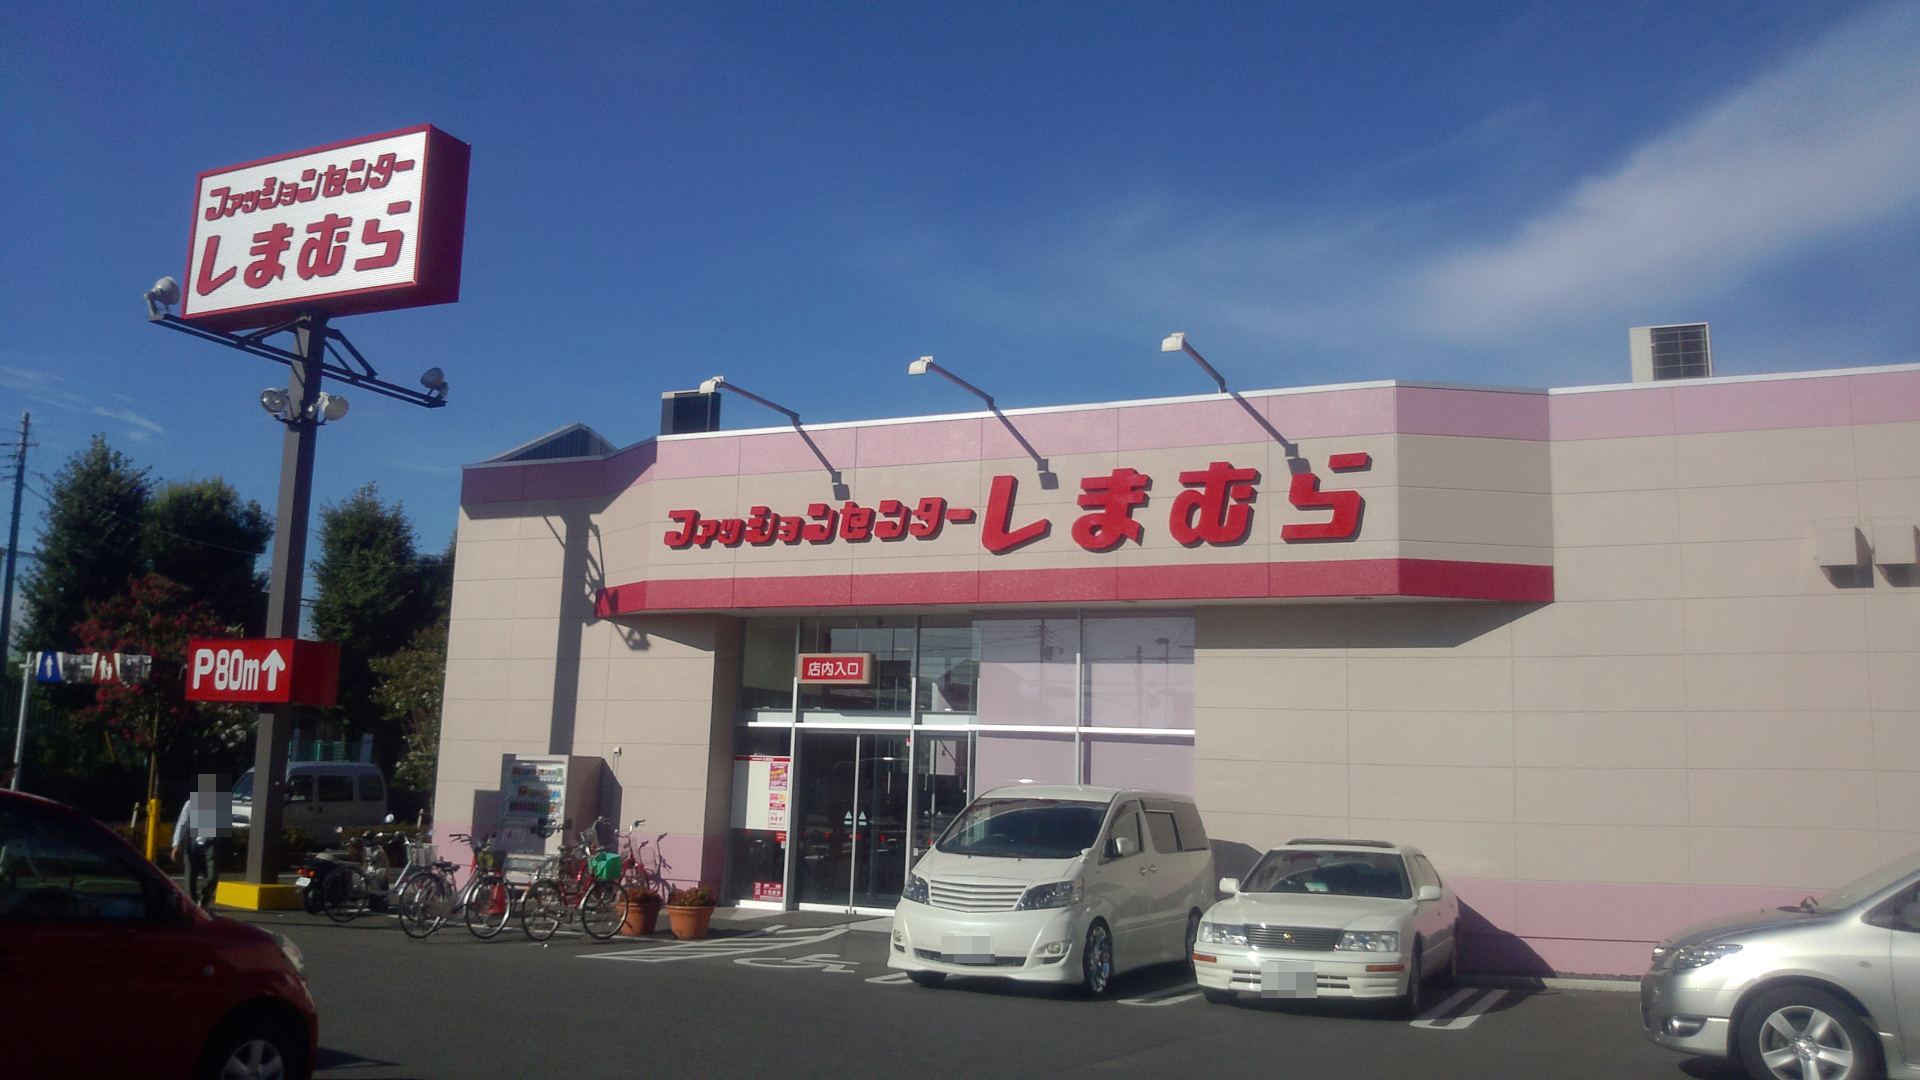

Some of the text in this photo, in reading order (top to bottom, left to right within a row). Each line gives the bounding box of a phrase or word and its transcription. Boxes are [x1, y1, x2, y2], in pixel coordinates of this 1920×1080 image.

[204, 152, 415, 221] ファッションセンター
[196, 200, 412, 296] しまむら
[664, 452, 1369, 552] ファッションセンター しまむら
[193, 648, 260, 691] P80m
[807, 661, 859, 677] 店内入口
